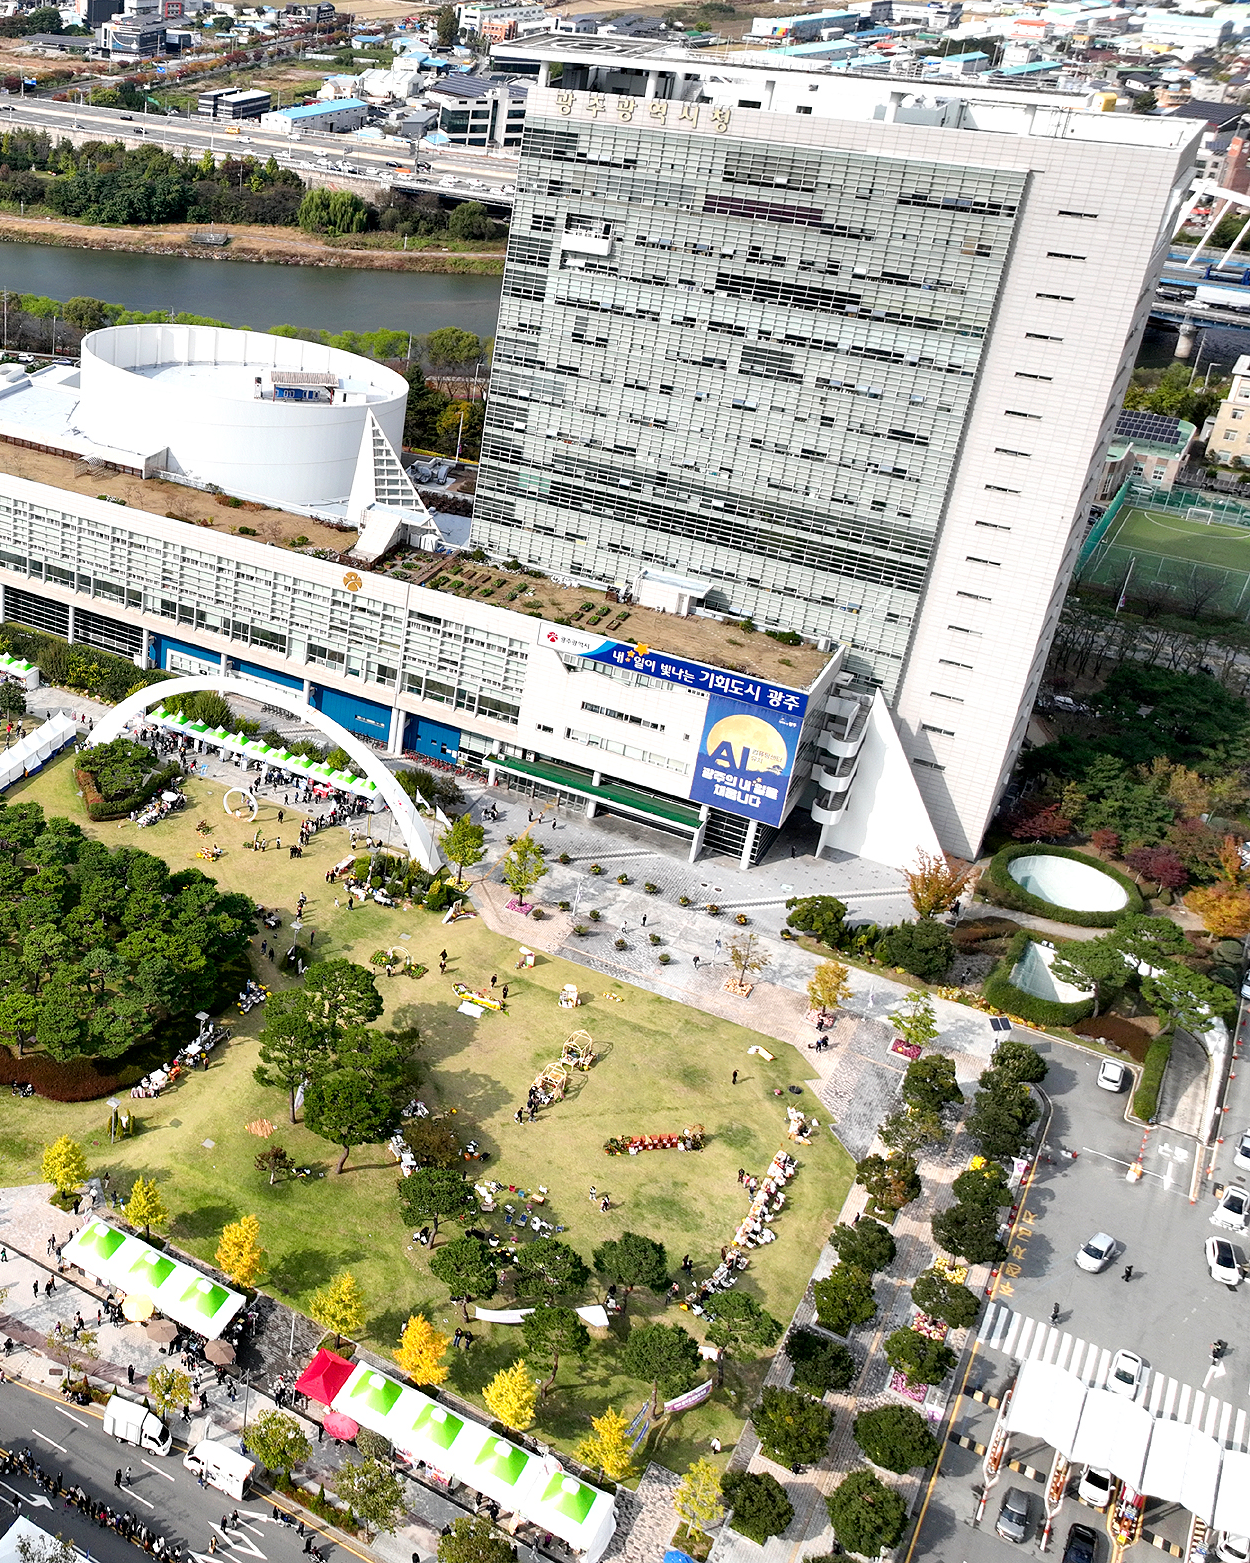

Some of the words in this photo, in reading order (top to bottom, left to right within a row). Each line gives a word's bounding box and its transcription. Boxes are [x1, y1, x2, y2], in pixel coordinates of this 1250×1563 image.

[555, 91, 732, 133] 광주광역시청
[560, 635, 590, 651] 광주광역시
[660, 663, 695, 683] 빛나는
[699, 670, 761, 702] 기회도시
[767, 689, 800, 711] 광주
[708, 740, 750, 771] AI
[701, 766, 738, 786] 광주의
